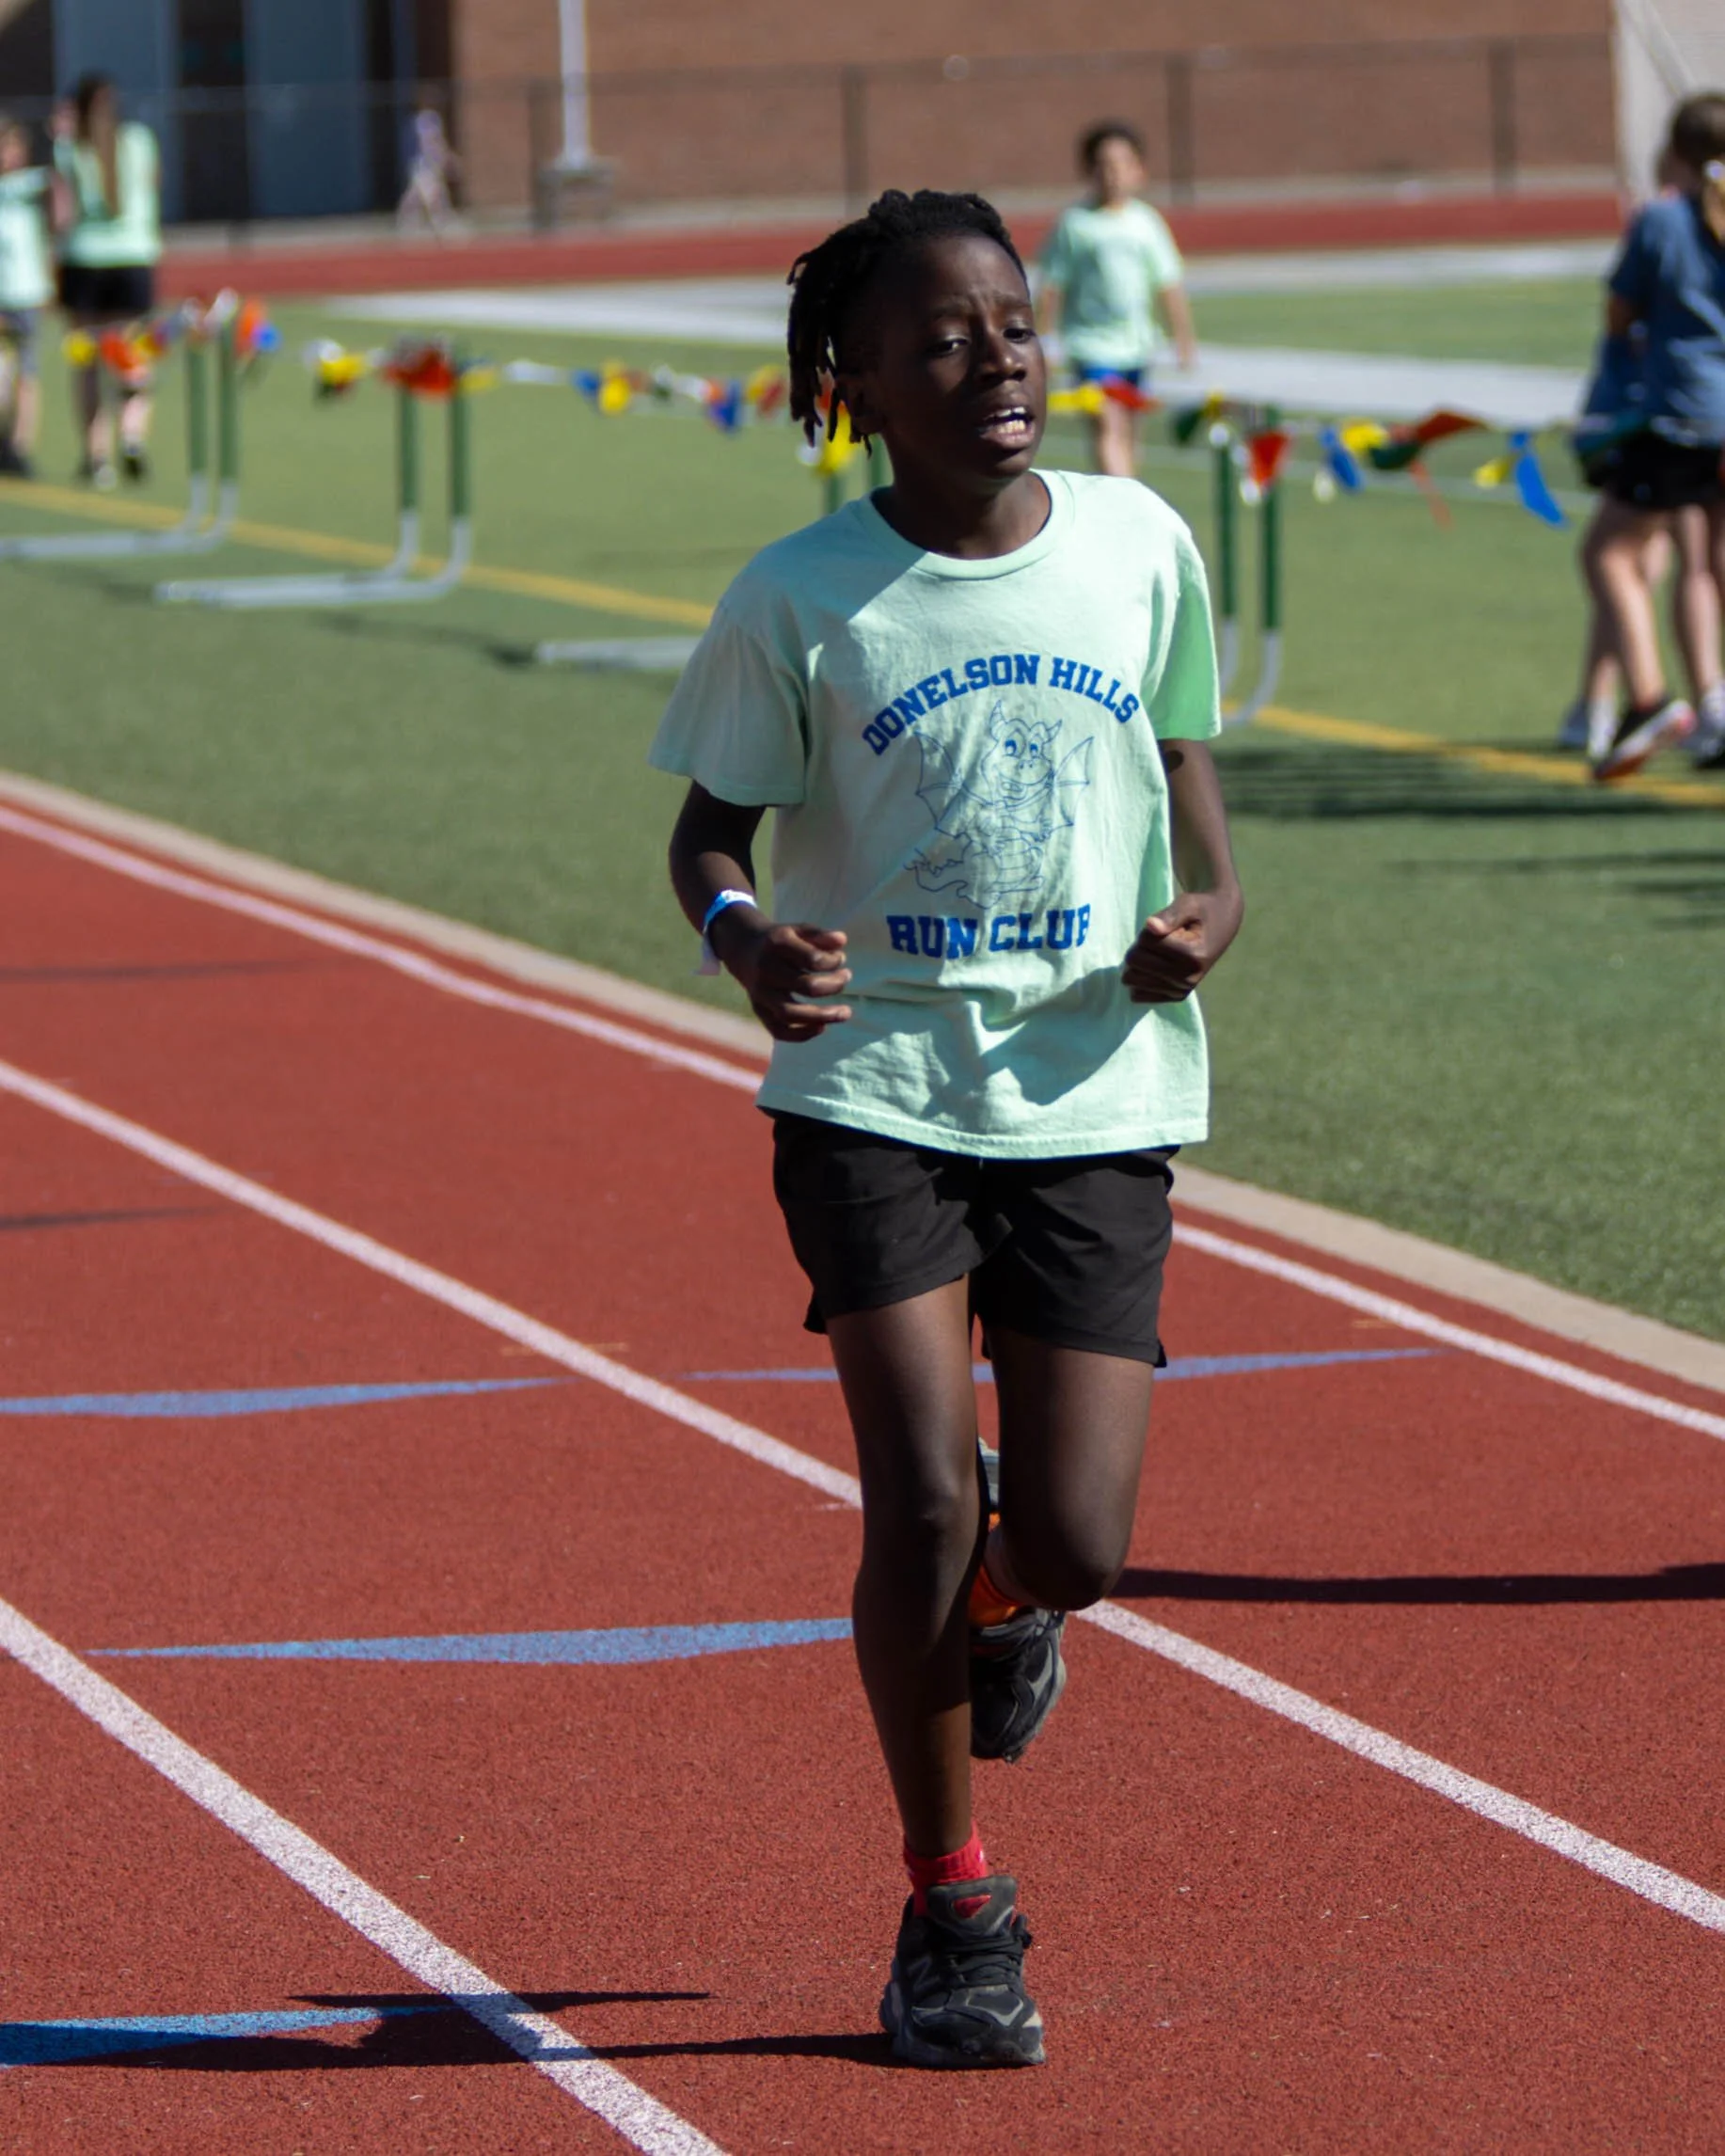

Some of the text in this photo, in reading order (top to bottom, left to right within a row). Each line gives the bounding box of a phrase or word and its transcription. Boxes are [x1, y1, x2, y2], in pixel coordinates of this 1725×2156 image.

[862, 655, 1139, 755] DONELSON HILLS
[887, 915, 977, 959] RUN
